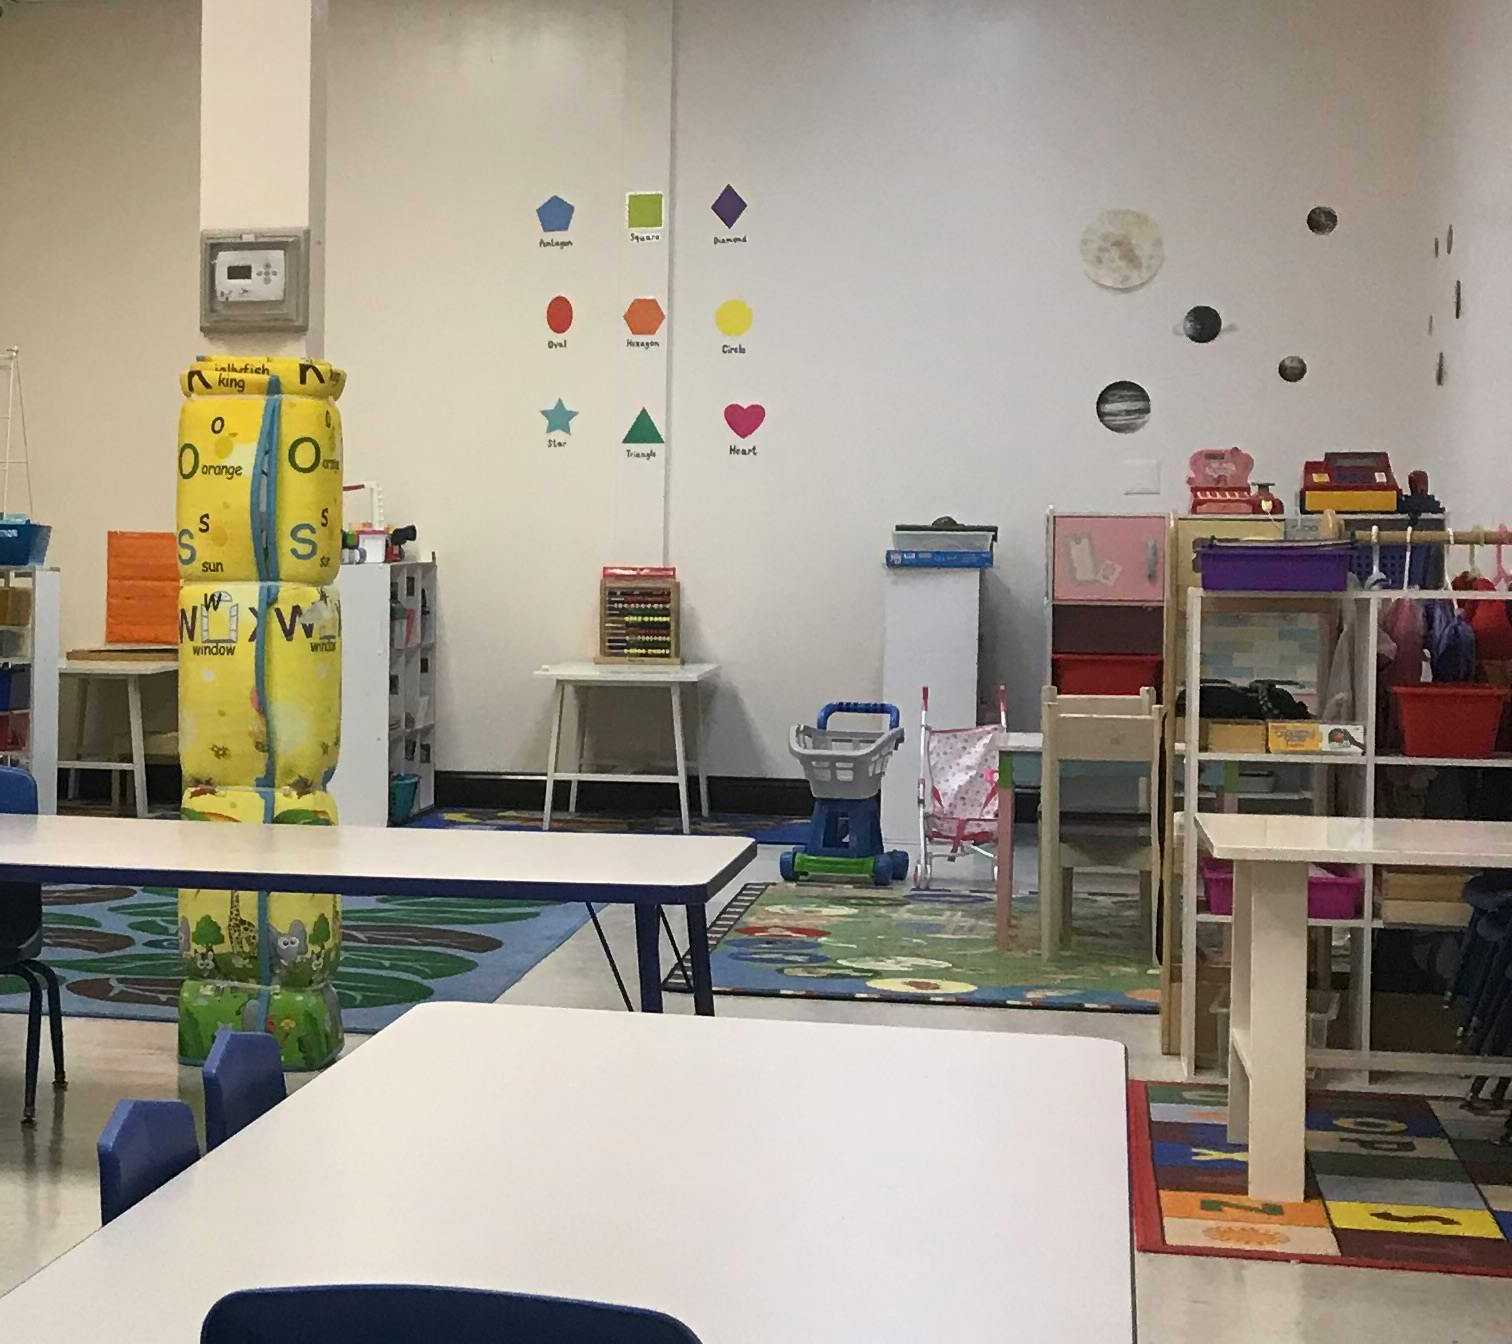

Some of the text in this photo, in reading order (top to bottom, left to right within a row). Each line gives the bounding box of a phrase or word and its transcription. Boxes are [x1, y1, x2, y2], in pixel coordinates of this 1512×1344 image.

[630, 233, 660, 243] Square
[713, 235, 747, 245] Diamond
[548, 340, 567, 349] Oval
[626, 339, 660, 350] Hexagon
[721, 344, 746, 354] Circle
[218, 373, 245, 392] king
[548, 439, 567, 448] Star
[288, 436, 321, 474] O
[626, 449, 657, 461] Triangle
[729, 445, 758, 456] Heart
[178, 443, 200, 480] O
[201, 464, 243, 480] orange
[290, 523, 318, 560] S
[201, 561, 224, 573] sun
[193, 644, 237, 656] window
